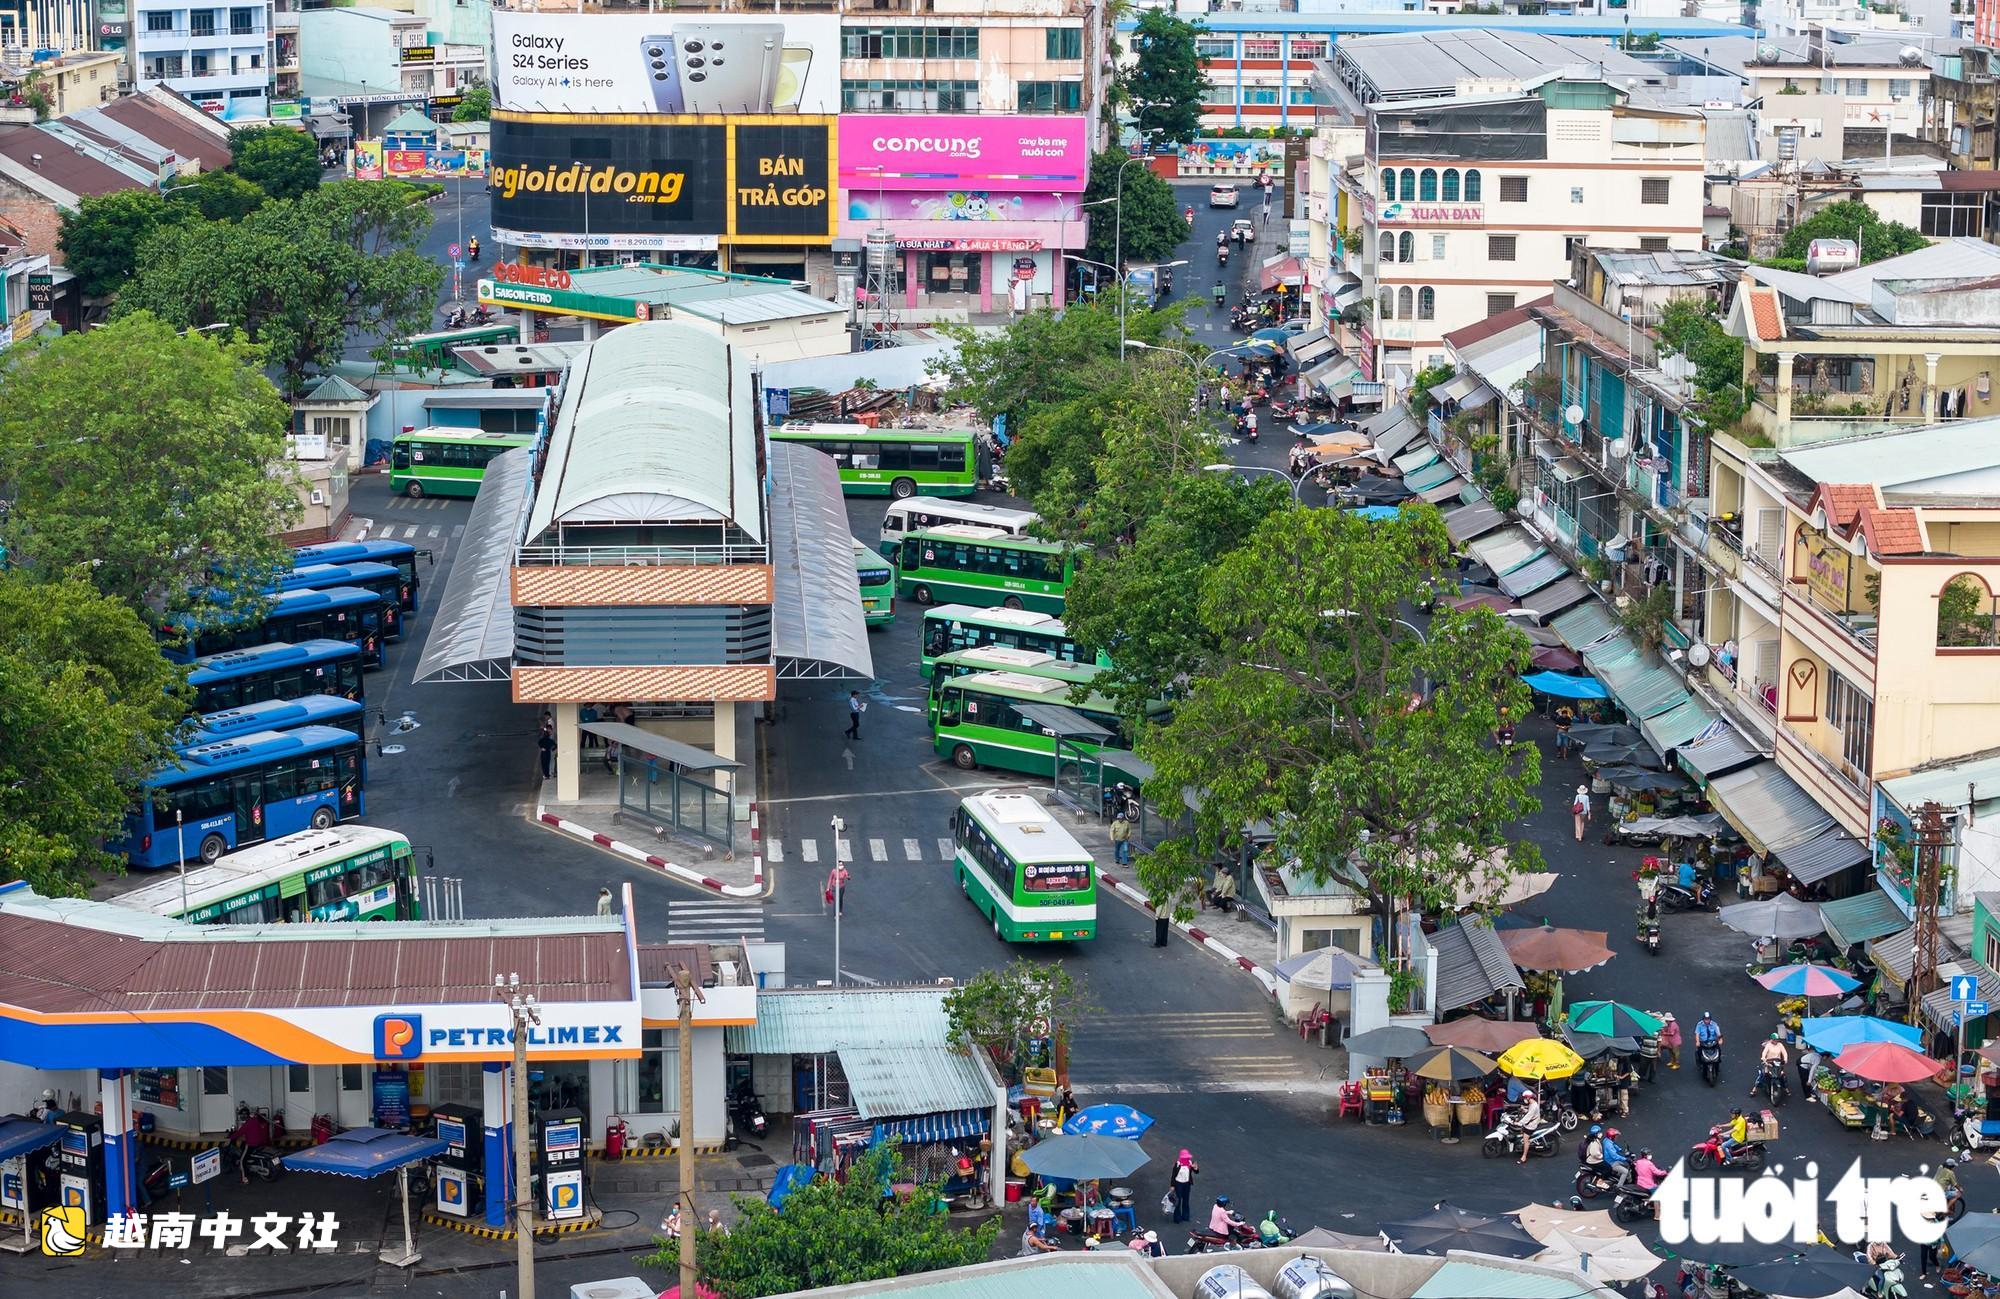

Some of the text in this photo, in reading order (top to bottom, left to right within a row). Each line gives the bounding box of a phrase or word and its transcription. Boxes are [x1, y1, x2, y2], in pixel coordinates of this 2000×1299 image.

[111, 26, 122, 34] LG
[512, 34, 564, 52] Galaxy
[512, 54, 589, 70] S24 Series
[512, 75, 614, 88] Galaxy AI is here
[872, 136, 982, 158] concung
[1038, 136, 1051, 147] ba
[1051, 138, 1068, 149] mẹ
[1021, 148, 1064, 157] nuôi con
[759, 153, 804, 176] BÁN
[625, 194, 656, 203] .com
[737, 182, 826, 206] TRẢ GÓP
[971, 240, 990, 250] MUA
[493, 261, 571, 290] COMECO
[30, 284, 52, 293] NGỌC
[32, 293, 50, 302] NGÀ
[495, 287, 553, 304] SAIGON PETRO
[226, 892, 260, 910] LONG AN
[1545, 1063, 1569, 1071] BONCHA
